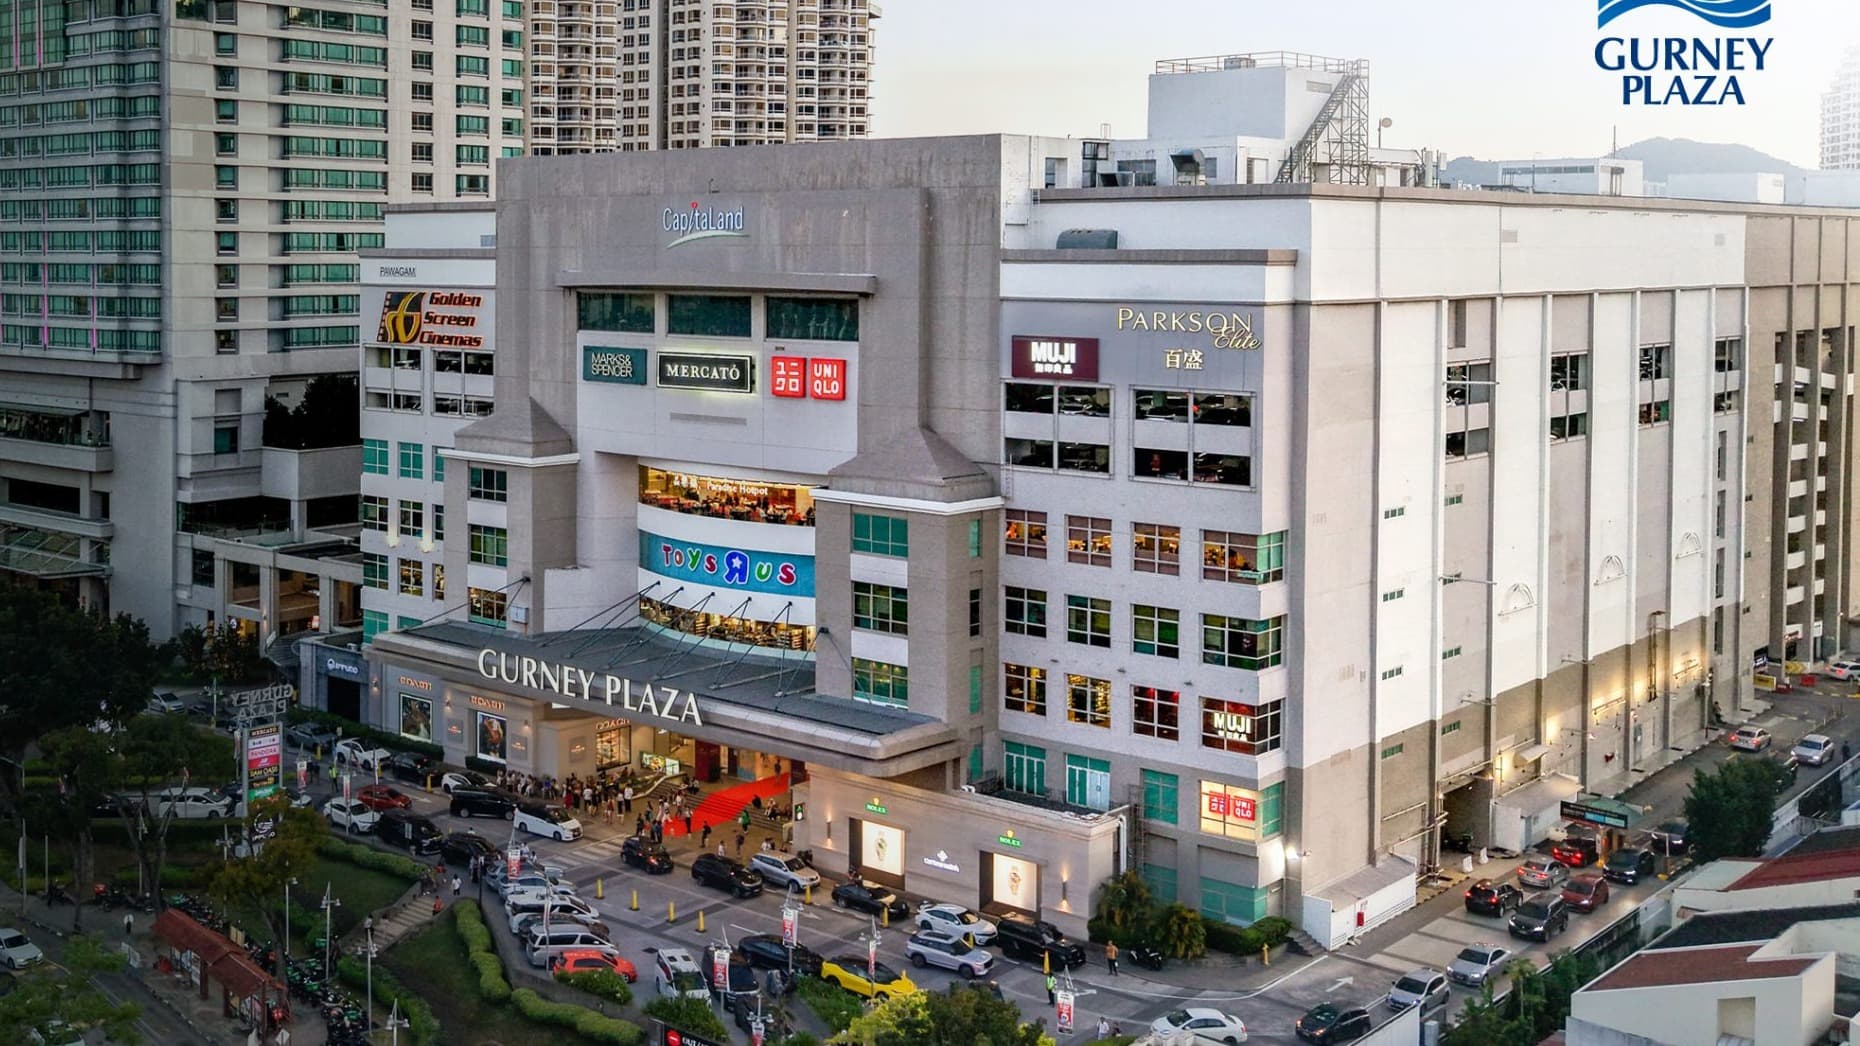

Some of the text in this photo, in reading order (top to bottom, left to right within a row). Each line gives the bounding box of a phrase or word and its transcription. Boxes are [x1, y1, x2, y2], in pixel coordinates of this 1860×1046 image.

[662, 201, 745, 237] CapitaLand
[380, 266, 417, 278] PAWAGAM
[429, 291, 482, 307] Golden
[423, 310, 476, 327] Screen
[1117, 307, 1252, 333] PARKSON
[418, 330, 482, 347] Cinemas
[1210, 325, 1261, 350] Elite
[1031, 341, 1076, 364] MUJI
[1162, 348, 1204, 370] 百盛
[591, 363, 633, 378] SPENCER
[661, 543, 718, 574] TOYS
[477, 648, 704, 727] GURNEY PLAZA
[1213, 712, 1251, 734] MUJI
